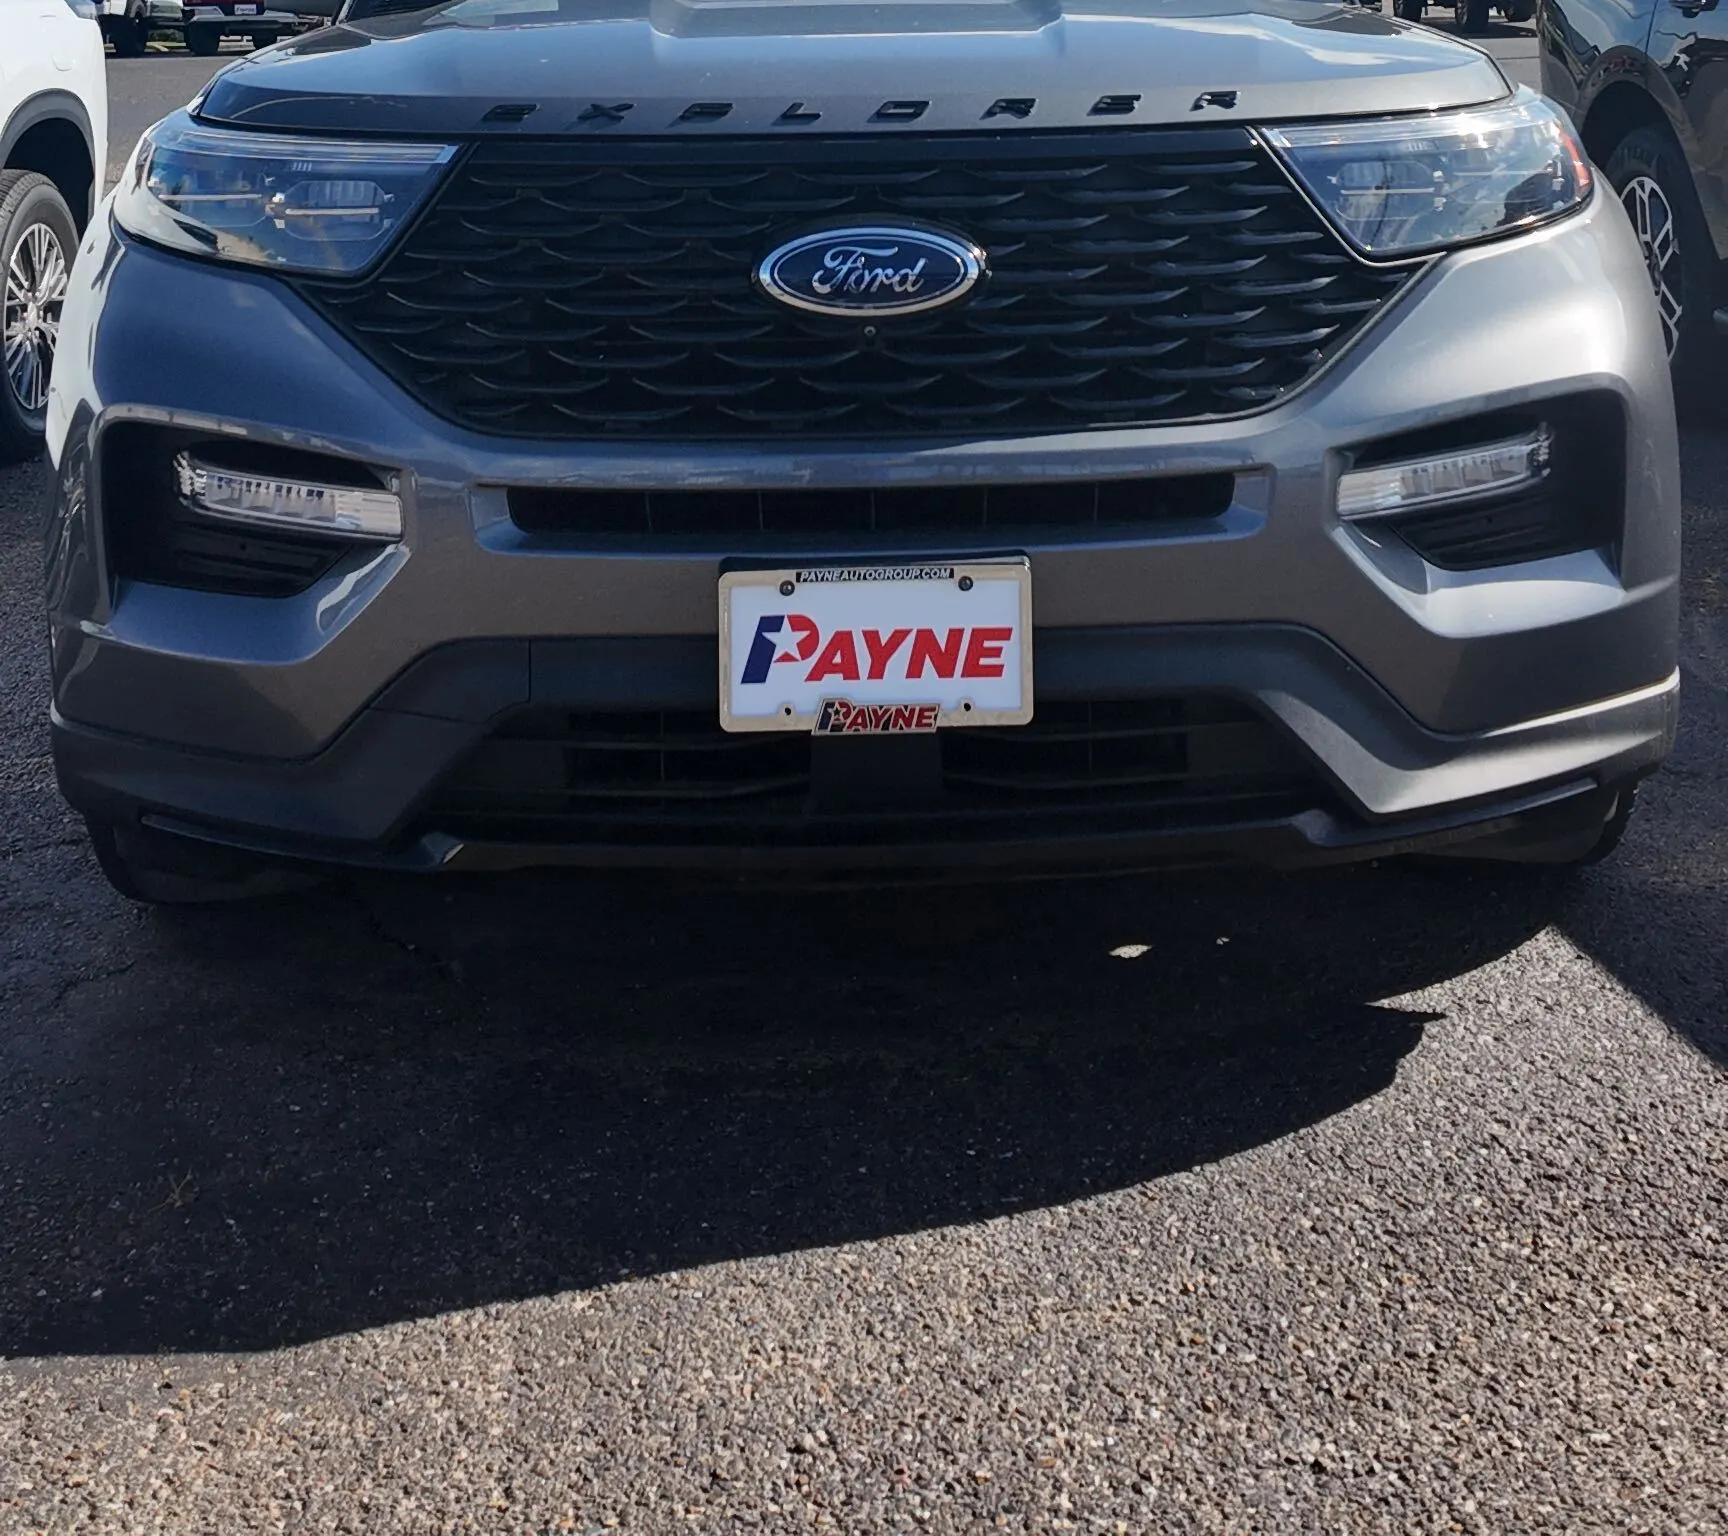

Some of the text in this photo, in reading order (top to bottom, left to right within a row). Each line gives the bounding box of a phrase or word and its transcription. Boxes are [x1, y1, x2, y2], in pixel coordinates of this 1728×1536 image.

[480, 90, 1241, 123] EXPLORER
[811, 246, 927, 294] Ford
[799, 568, 951, 582] PAYNEAUTOGROUP.COM
[740, 614, 1014, 684] PAYNE
[817, 699, 938, 731] PAYNE
